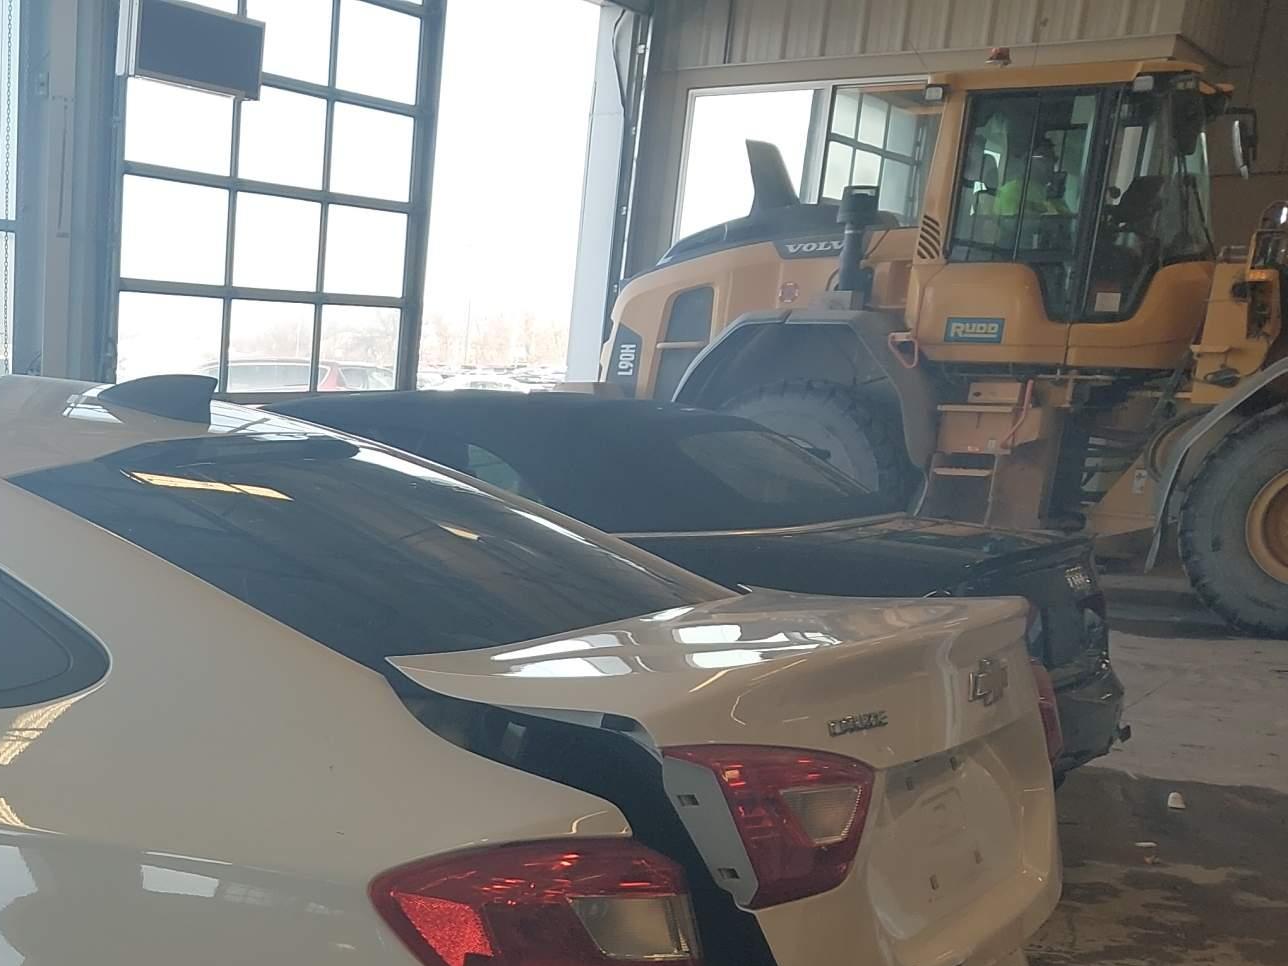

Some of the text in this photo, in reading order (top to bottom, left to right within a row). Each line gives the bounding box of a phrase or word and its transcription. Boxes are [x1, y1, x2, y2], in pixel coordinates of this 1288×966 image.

[784, 240, 847, 253] VOLV
[951, 322, 999, 338] RUDD
[617, 344, 636, 376] L90H
